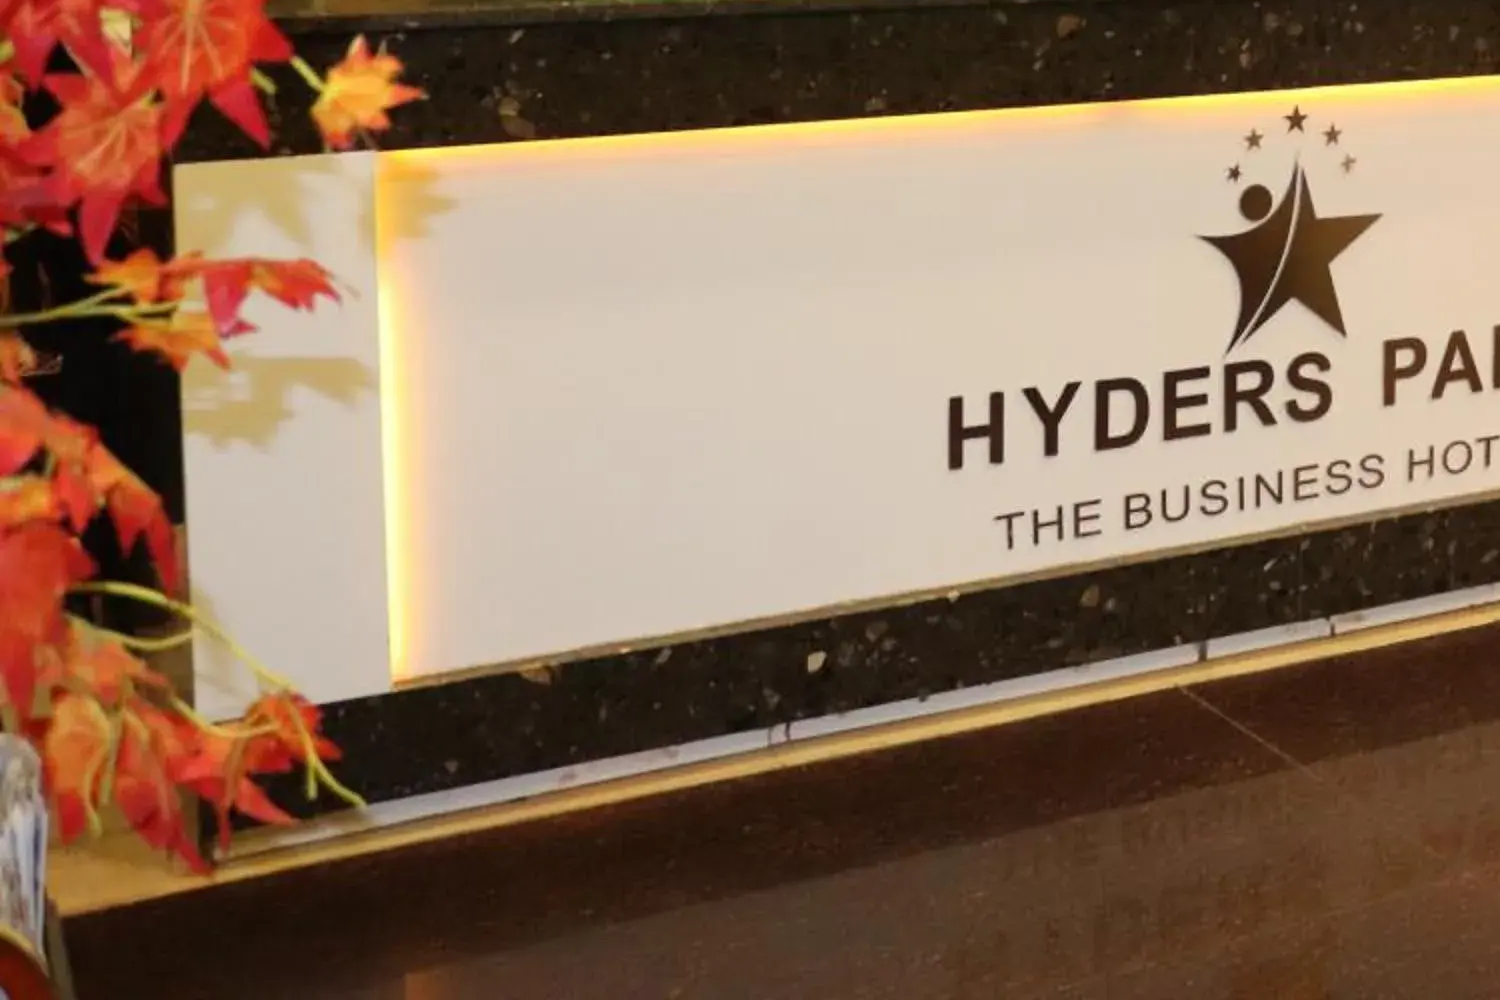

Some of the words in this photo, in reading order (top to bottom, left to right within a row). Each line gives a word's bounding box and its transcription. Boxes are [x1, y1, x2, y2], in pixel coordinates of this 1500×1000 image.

[947, 352, 1333, 471] HYDERS
[994, 499, 1102, 551] THE
[1123, 453, 1386, 531] BUSINESS
